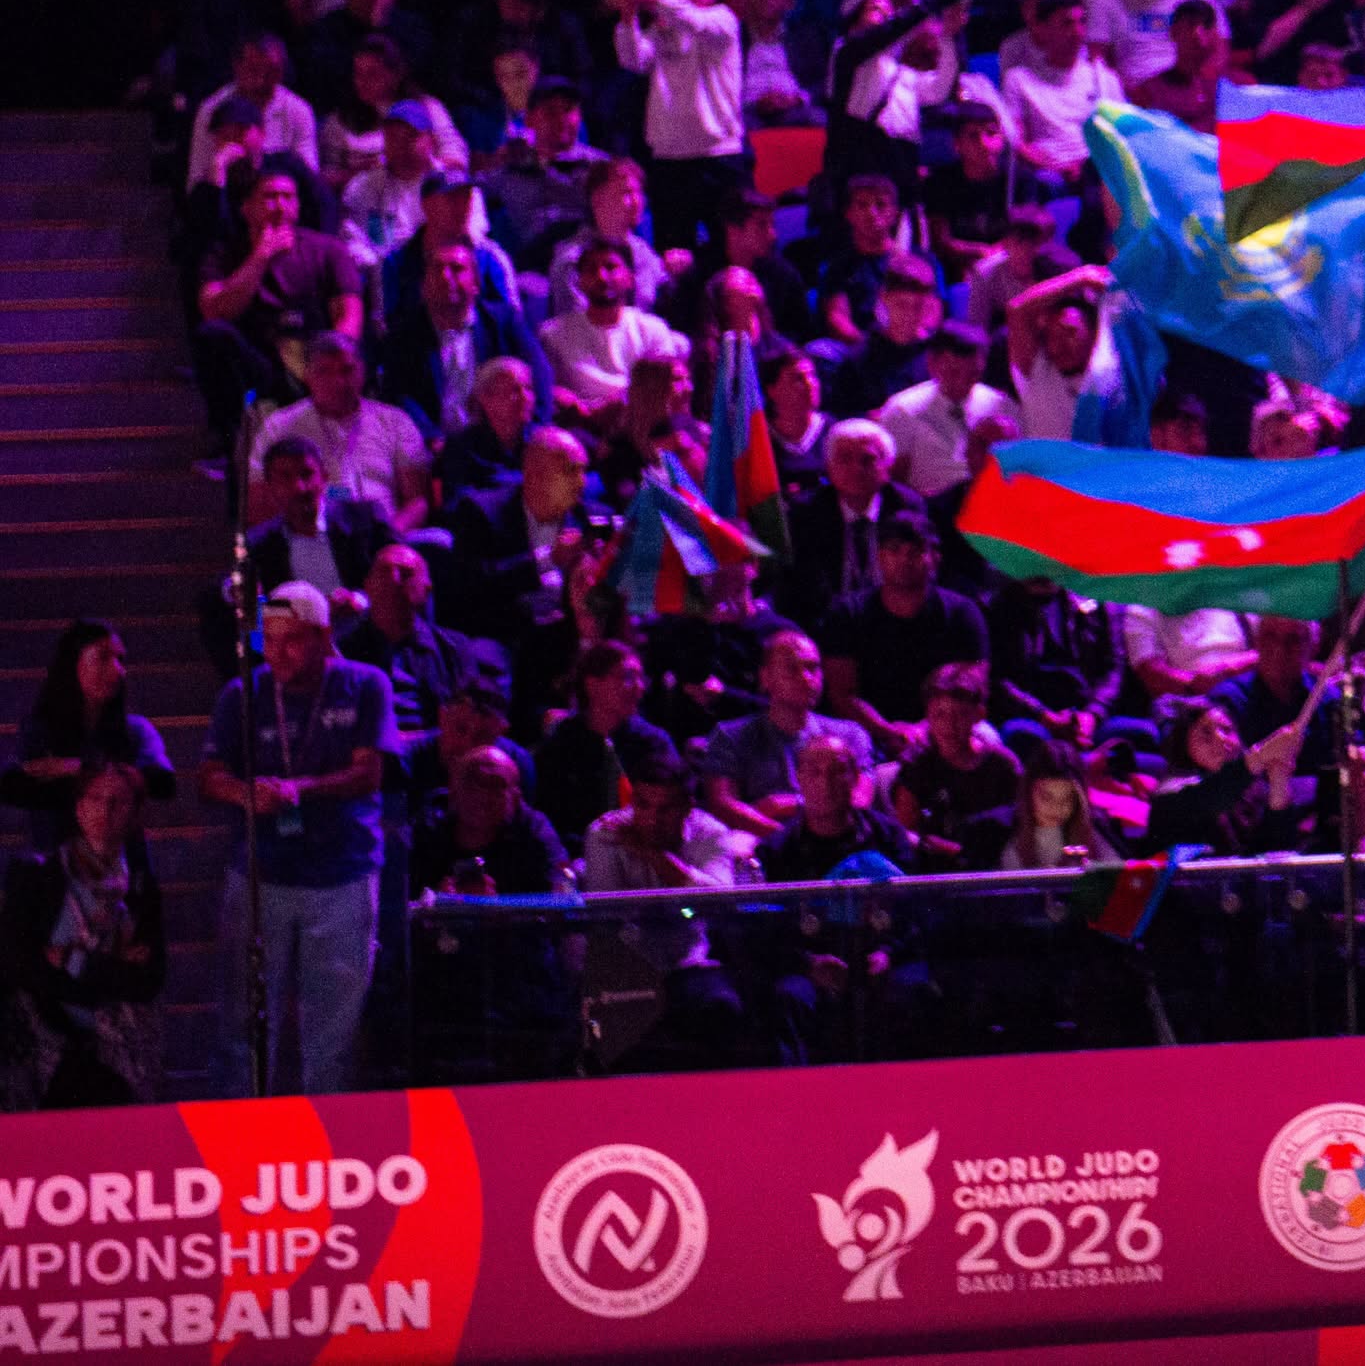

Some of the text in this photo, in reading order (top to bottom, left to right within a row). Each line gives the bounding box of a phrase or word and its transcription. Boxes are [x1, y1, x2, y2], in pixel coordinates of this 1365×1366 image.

[241, 1154, 428, 1215] JUDO
[953, 1148, 1160, 1184] WORLD JUDO
[955, 1201, 1163, 1273] 2026
[0, 1279, 431, 1355] AZERBAIJAN
